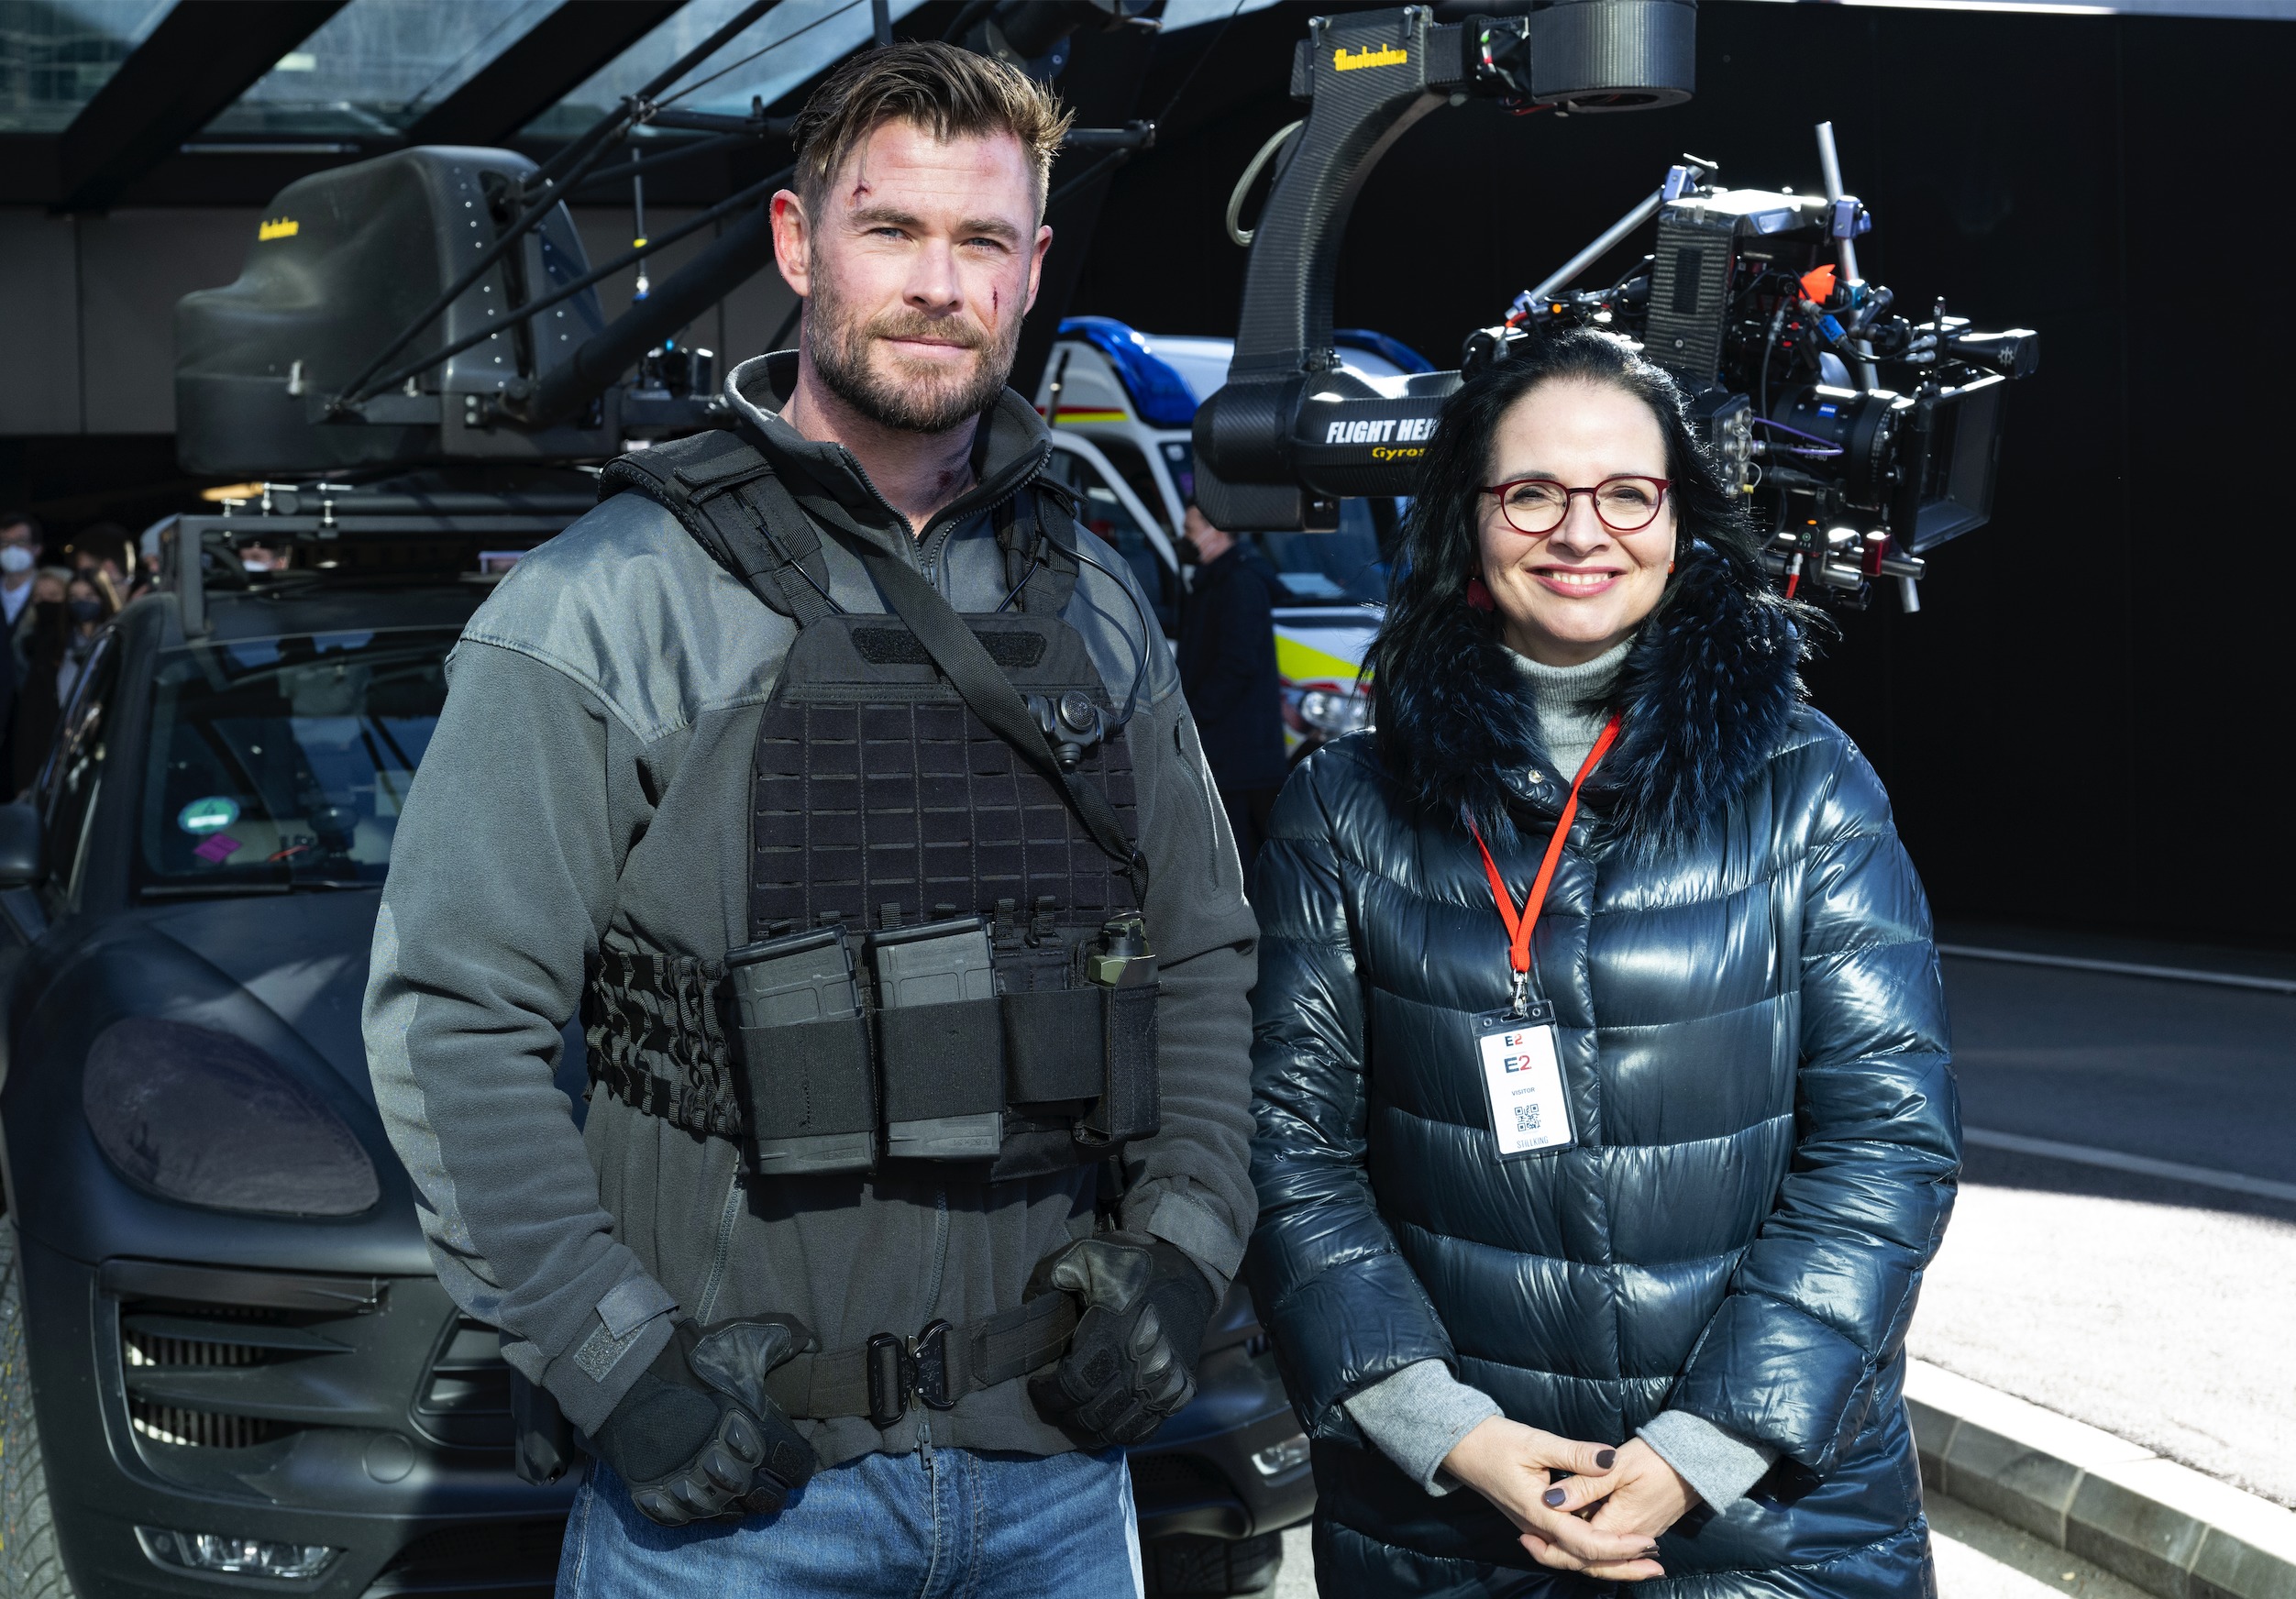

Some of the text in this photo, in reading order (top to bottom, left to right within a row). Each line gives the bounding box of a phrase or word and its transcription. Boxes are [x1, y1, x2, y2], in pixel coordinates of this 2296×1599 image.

[1326, 418, 1440, 443] FLIGHT HEA
[1372, 447, 1426, 461] Gyros
[1504, 1033, 1523, 1047] E2
[1504, 1054, 1532, 1074] E2
[1511, 1086, 1536, 1097] VISITOR
[1517, 1136, 1549, 1149] STILLKING
